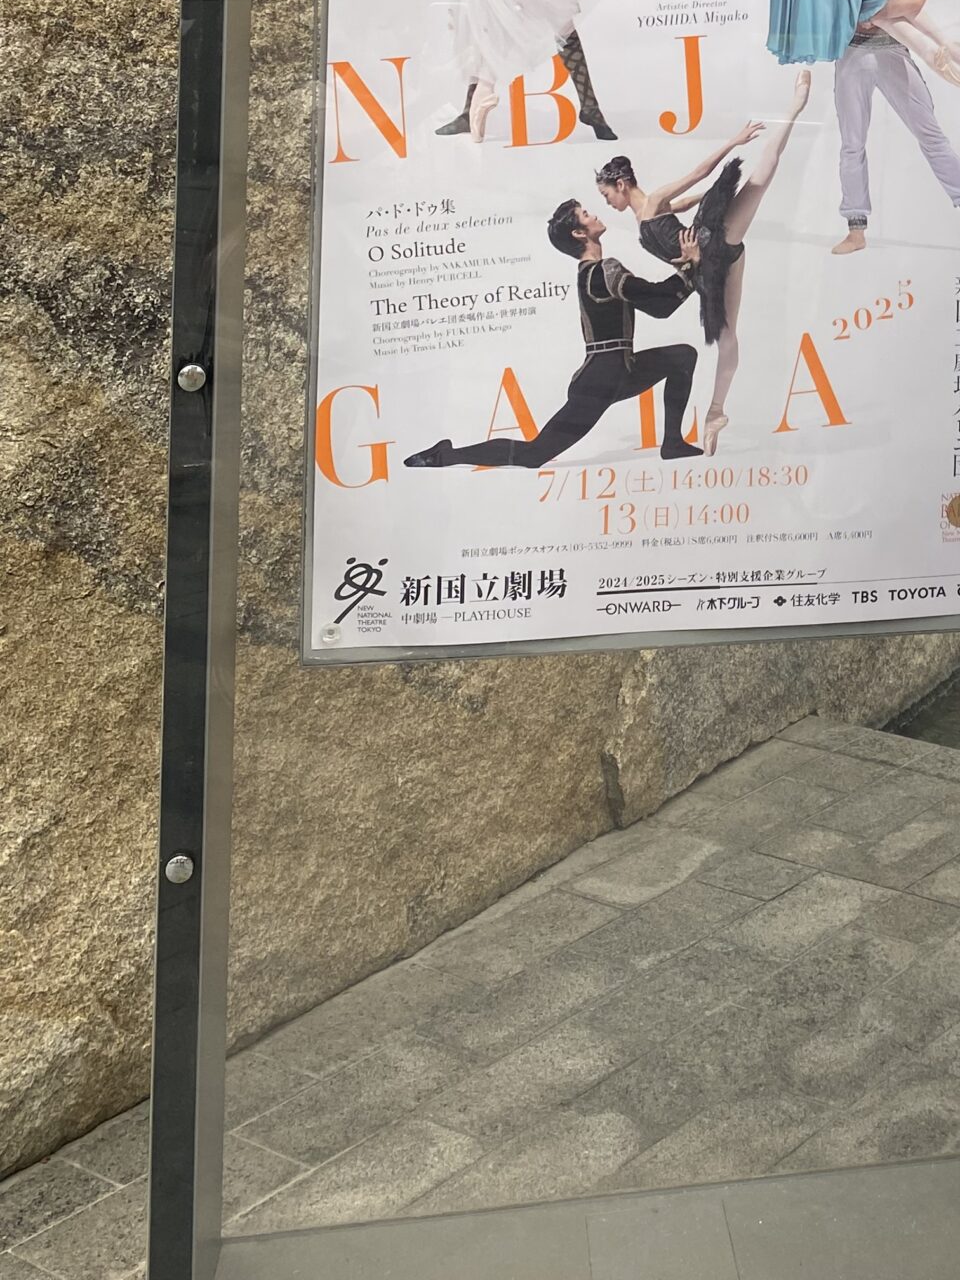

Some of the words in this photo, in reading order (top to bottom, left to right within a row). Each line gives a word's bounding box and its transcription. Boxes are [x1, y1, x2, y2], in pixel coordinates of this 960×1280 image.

[656, 2, 689, 11] Artistic
[692, 0, 728, 10] Director
[637, 13, 699, 28] YOSHIDA
[704, 10, 749, 26] Miyako
[366, 225, 389, 238] Pas
[395, 223, 411, 235] de
[416, 221, 450, 233] deux
[455, 214, 514, 229] selection
[368, 245, 384, 263] O
[391, 238, 466, 260] Solitude
[368, 265, 428, 278] Choreography
[429, 263, 440, 272] by
[442, 258, 496, 270] NAKAMURA
[498, 255, 532, 265] Megumi
[369, 280, 396, 290] Music
[408, 276, 435, 287] Henry
[437, 271, 483, 283] PURCELL
[370, 298, 407, 316] The
[413, 293, 479, 311] Theory
[484, 286, 505, 304] of
[508, 281, 571, 301] Reality
[832, 279, 914, 341] 2025
[372, 332, 431, 346] Choreography
[434, 329, 443, 339] by
[446, 326, 486, 337] FUKUDA
[488, 323, 513, 334] Keigo
[374, 347, 398, 358] Music
[400, 345, 410, 356] by
[412, 343, 436, 354] Travis
[438, 339, 465, 350] LAKE
[400, 568, 568, 607] 新国立劇場
[852, 590, 878, 604] TBS
[888, 586, 946, 602] TOYOTA
[604, 600, 673, 616] ONWARD
[706, 597, 761, 610] 木下グループ
[790, 592, 841, 608] 住友化学
[454, 608, 532, 623] PLAYHOUSE
